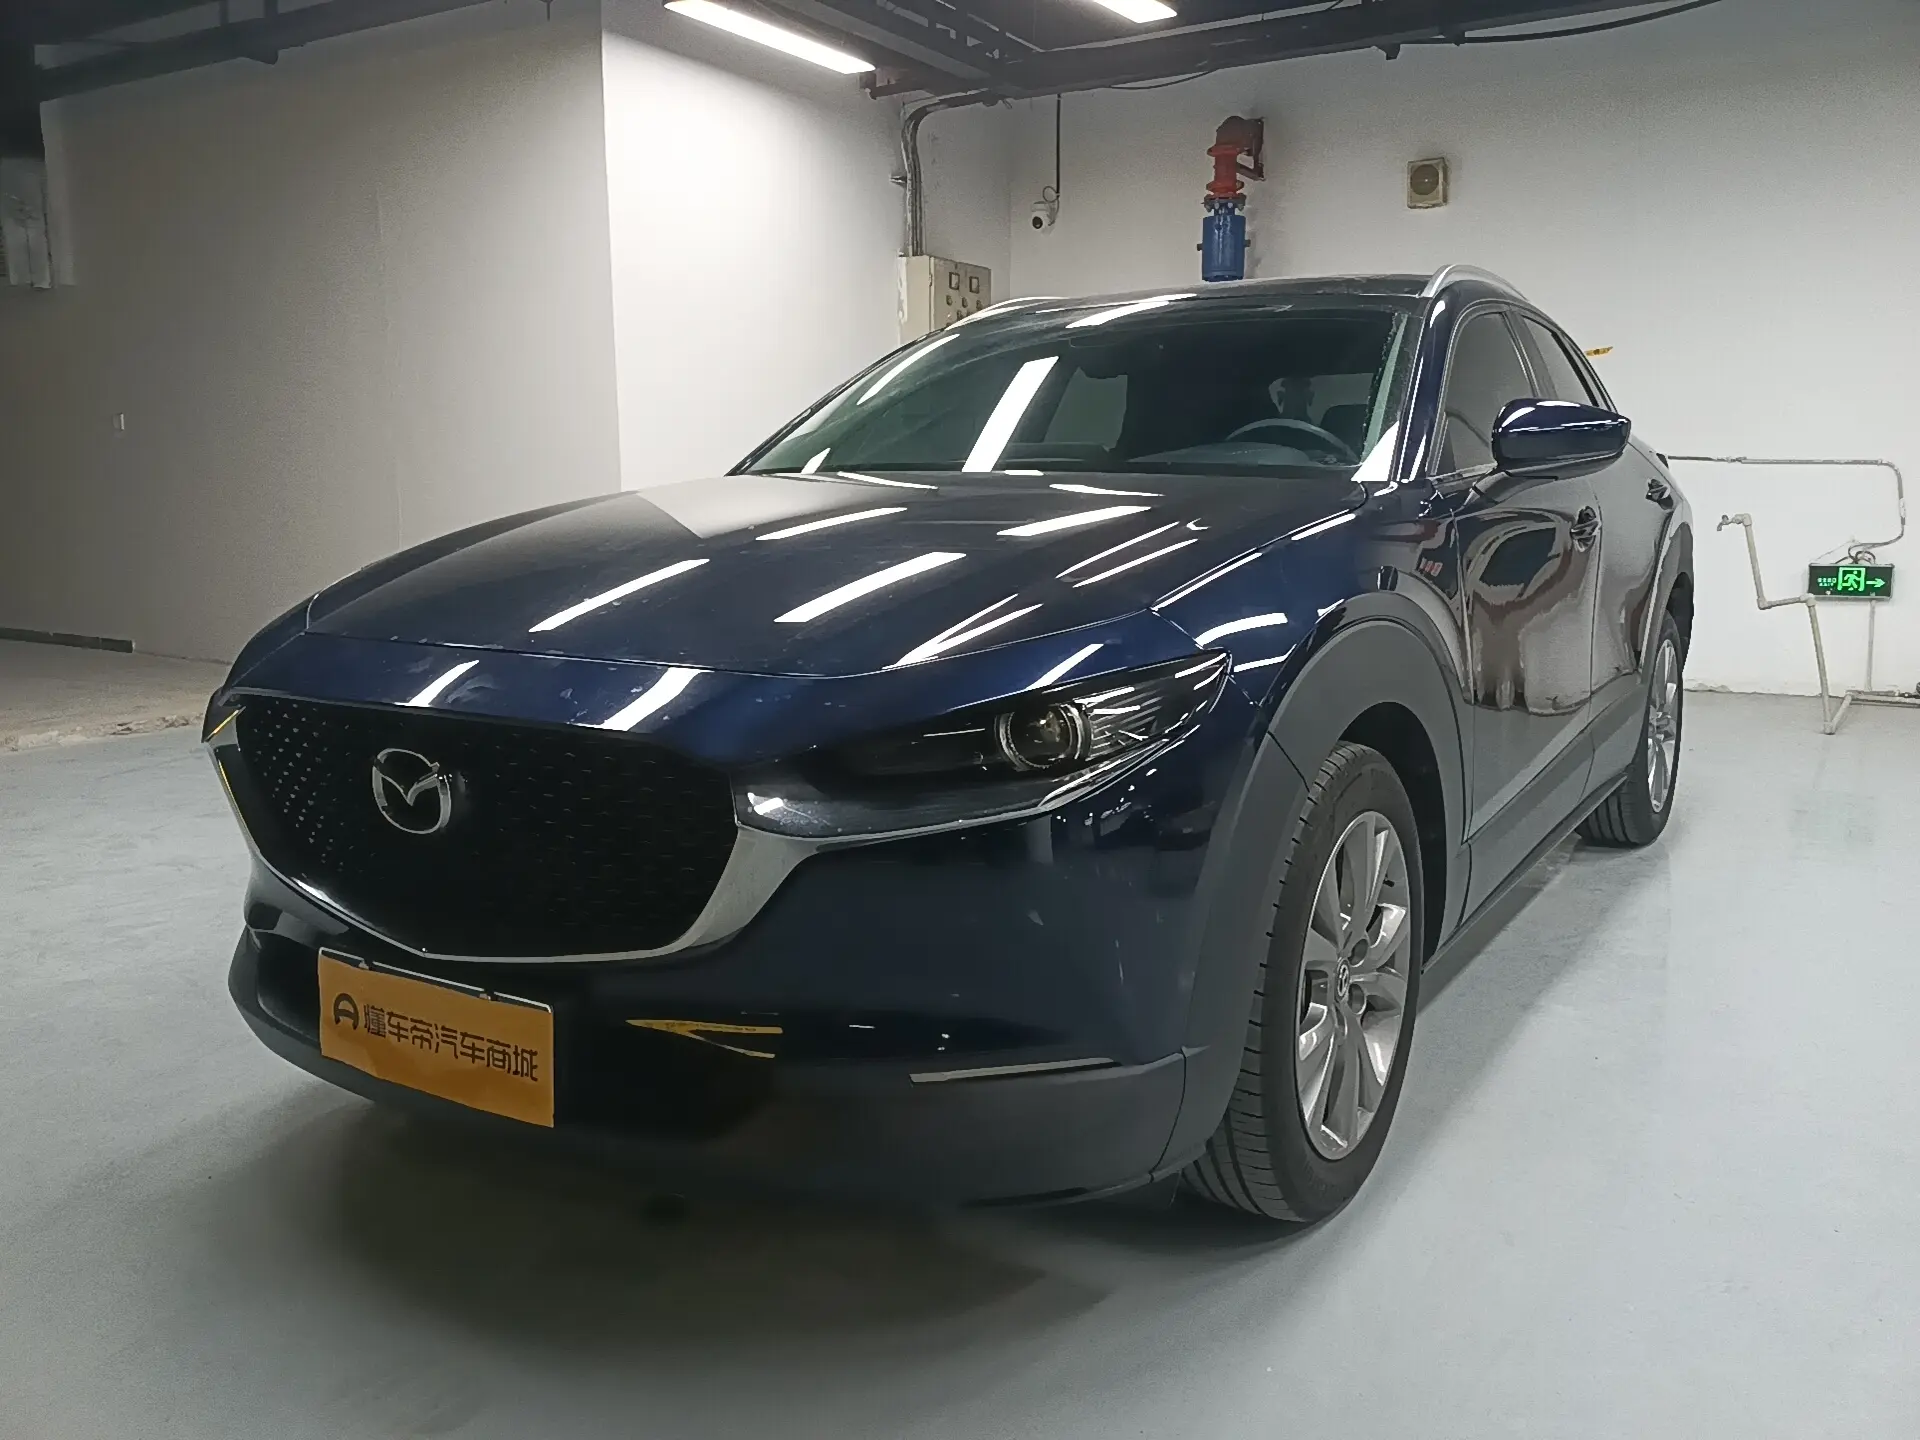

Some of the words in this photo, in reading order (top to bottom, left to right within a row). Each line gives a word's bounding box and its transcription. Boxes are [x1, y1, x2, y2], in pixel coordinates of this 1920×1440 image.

[363, 1004, 539, 1082] 懂车帝汽车商城
